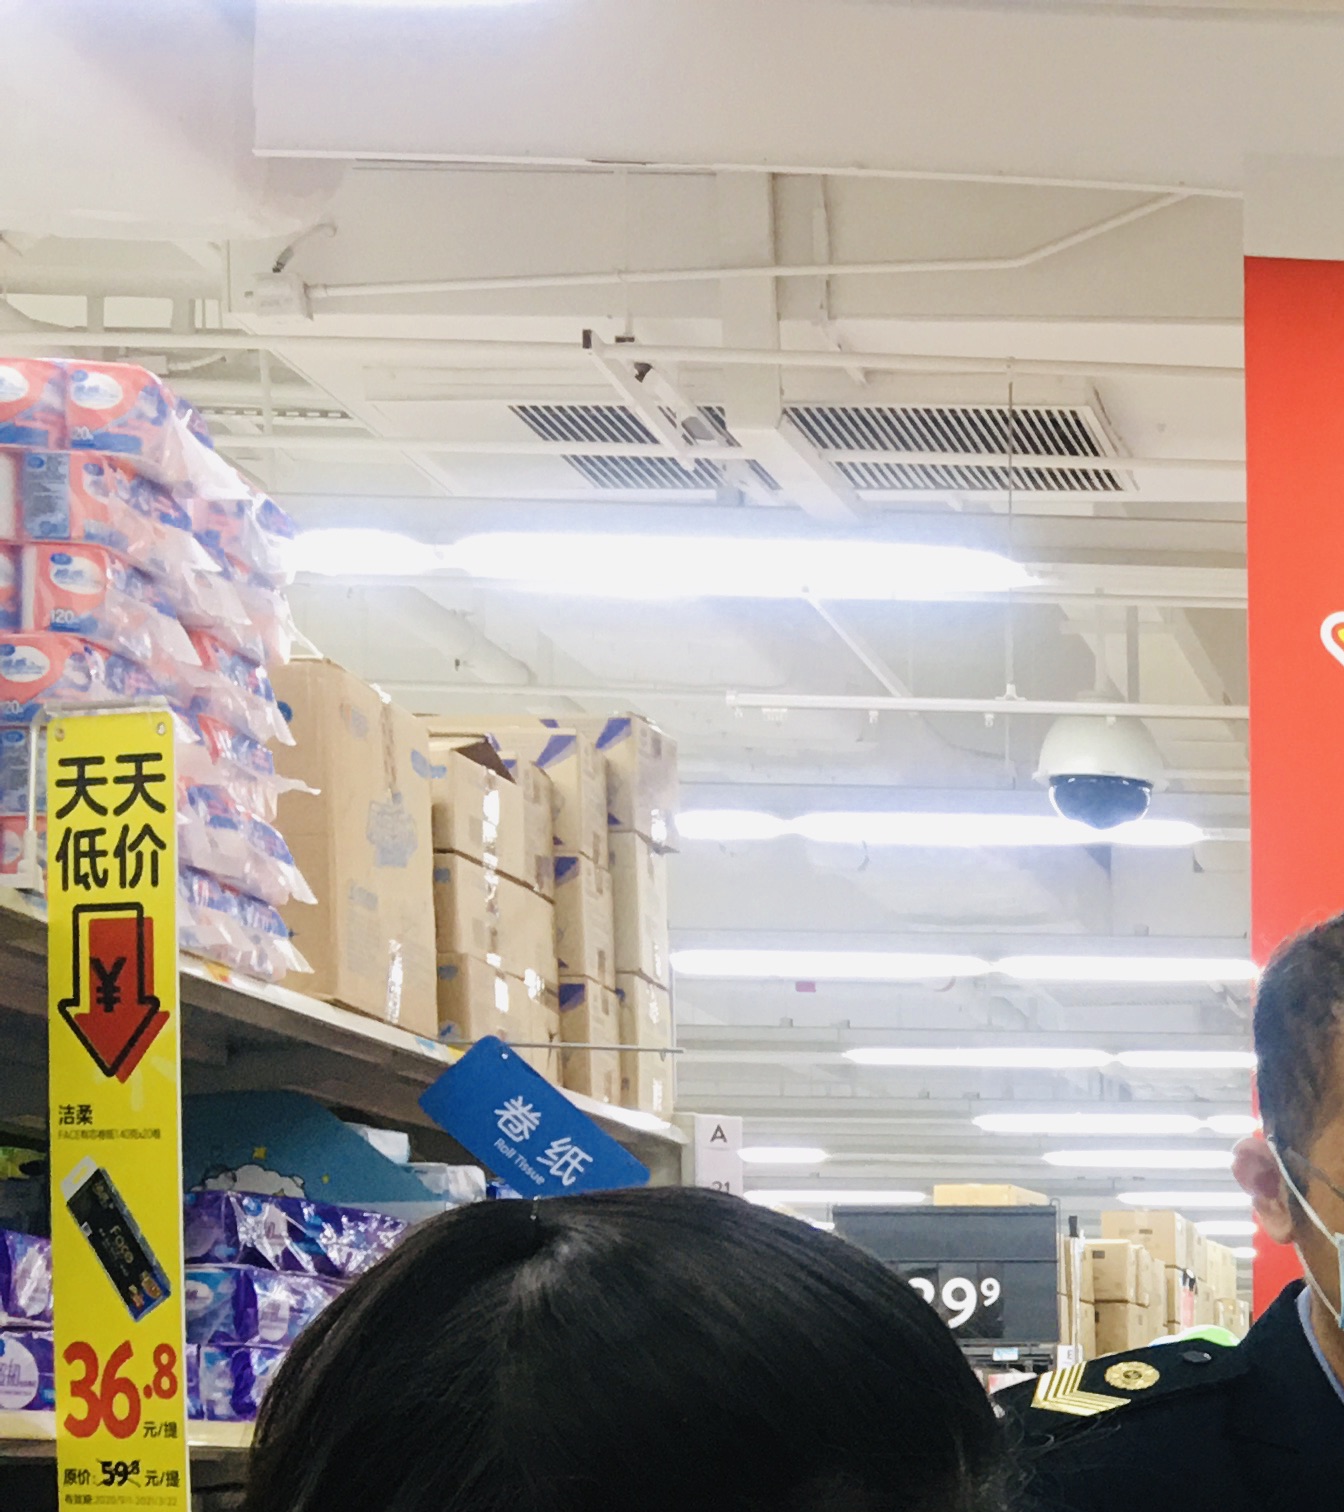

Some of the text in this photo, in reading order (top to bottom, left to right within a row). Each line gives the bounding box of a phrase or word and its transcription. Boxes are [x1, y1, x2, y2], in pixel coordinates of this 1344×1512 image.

[55, 752, 167, 821] 天天
[55, 822, 167, 892] 低价
[57, 1104, 95, 1127] 洁柔
[709, 1124, 728, 1143] A
[493, 1095, 594, 1187] 卷纸
[493, 1137, 546, 1187] Roll Tissue
[62, 1339, 179, 1440] 36.8
[142, 1420, 179, 1440] 元/提
[144, 1469, 180, 1488] 元/提
